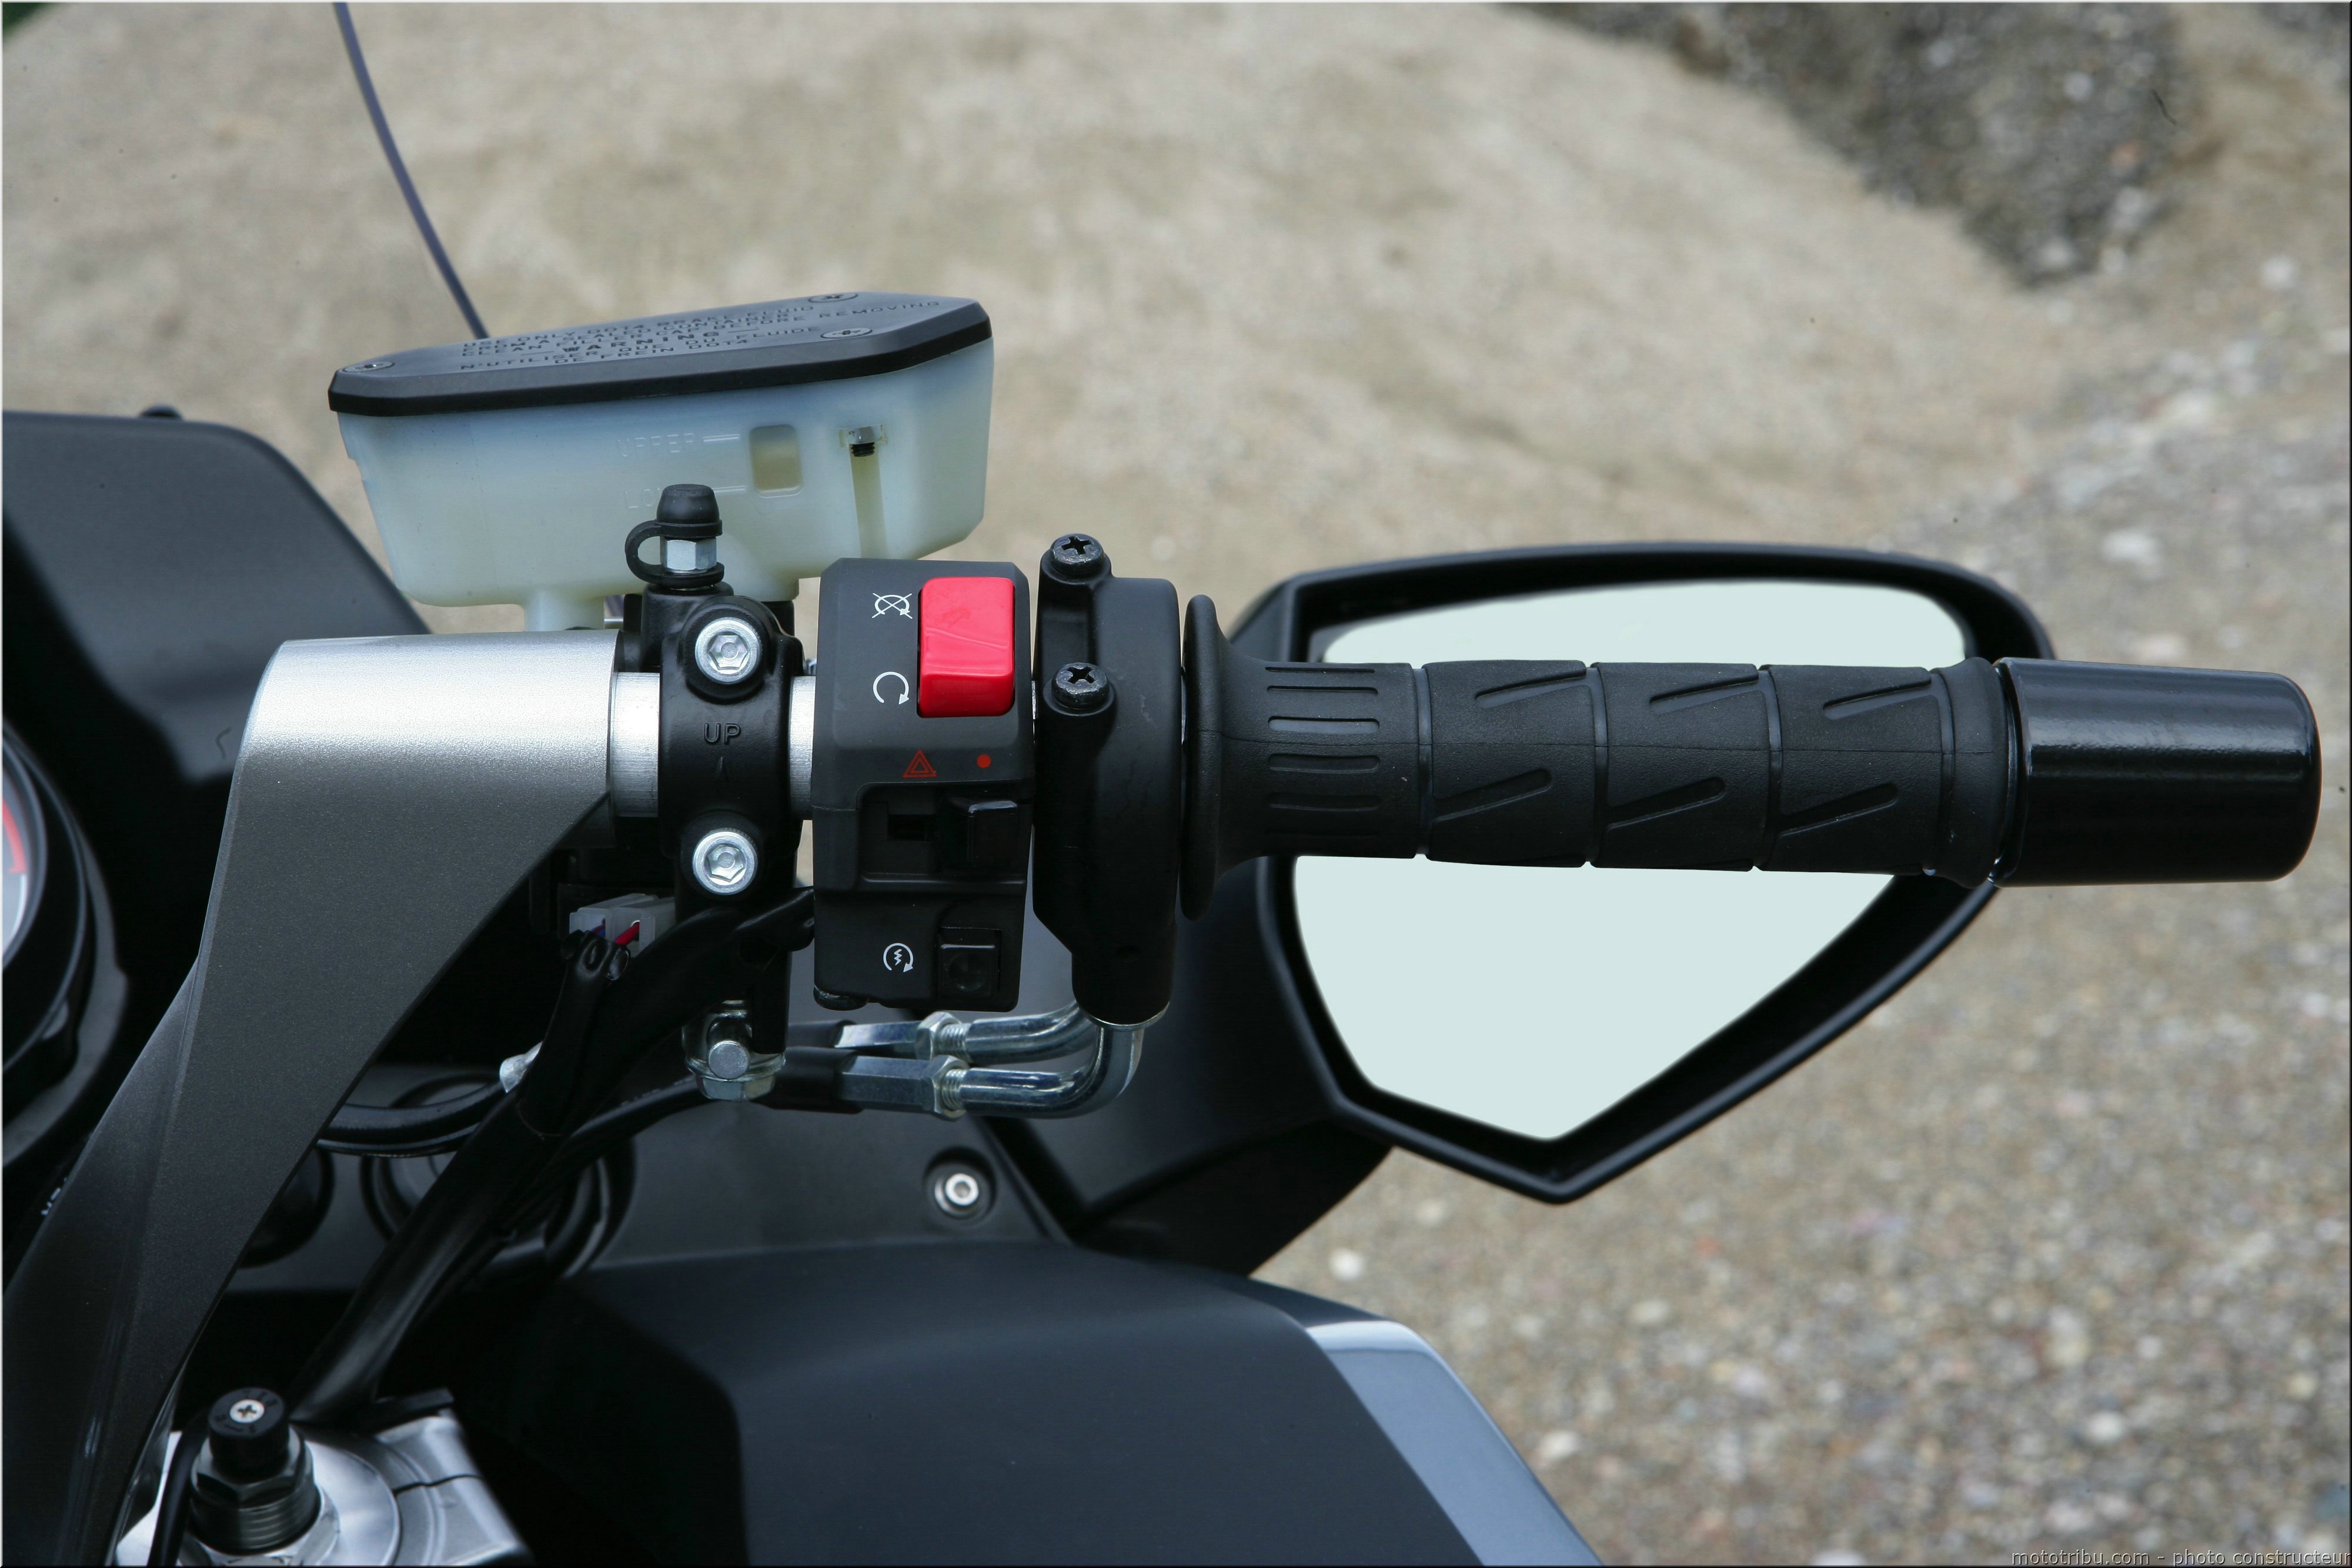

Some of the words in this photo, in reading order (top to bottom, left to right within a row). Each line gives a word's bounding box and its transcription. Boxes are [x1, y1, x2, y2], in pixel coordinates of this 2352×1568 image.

[462, 345, 542, 356] CLEAN
[556, 334, 643, 347] FILLER
[656, 327, 700, 336] CAP
[819, 301, 940, 318] REMOVING
[463, 342, 526, 352] FROM
[562, 328, 652, 341] SEALED
[464, 339, 509, 347] USE
[517, 331, 576, 341] ONLY
[587, 325, 645, 334] DOT4
[619, 343, 666, 352] QUE
[736, 326, 819, 339] FLUIDE
[562, 331, 720, 352] WARNING
[600, 347, 674, 359] FREIN
[689, 339, 749, 349] DOT4
[617, 433, 696, 457] UPPER
[703, 723, 741, 745] UP
